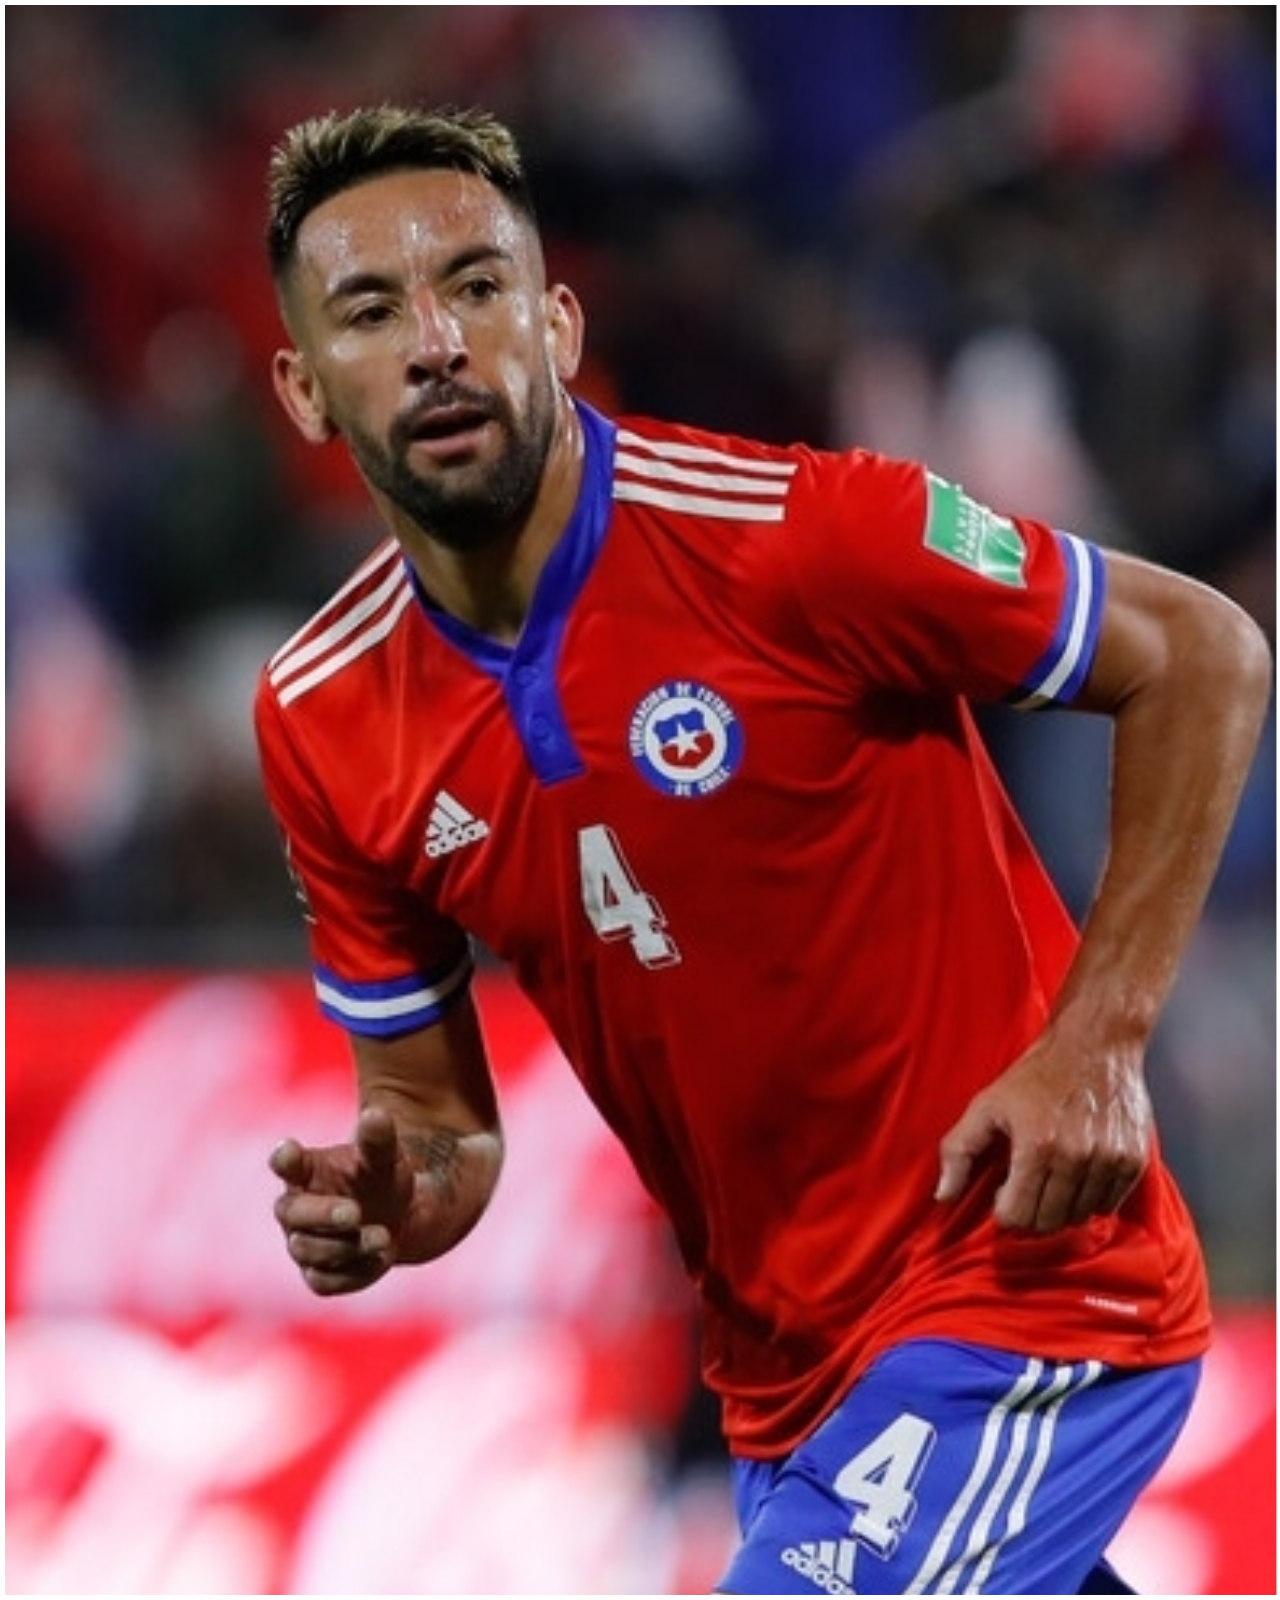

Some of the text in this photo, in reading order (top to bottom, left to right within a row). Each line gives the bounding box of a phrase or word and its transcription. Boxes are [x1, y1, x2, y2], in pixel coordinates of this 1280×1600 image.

[425, 820, 489, 857] adidas
[578, 823, 681, 969] 4
[833, 1412, 937, 1561] 4
